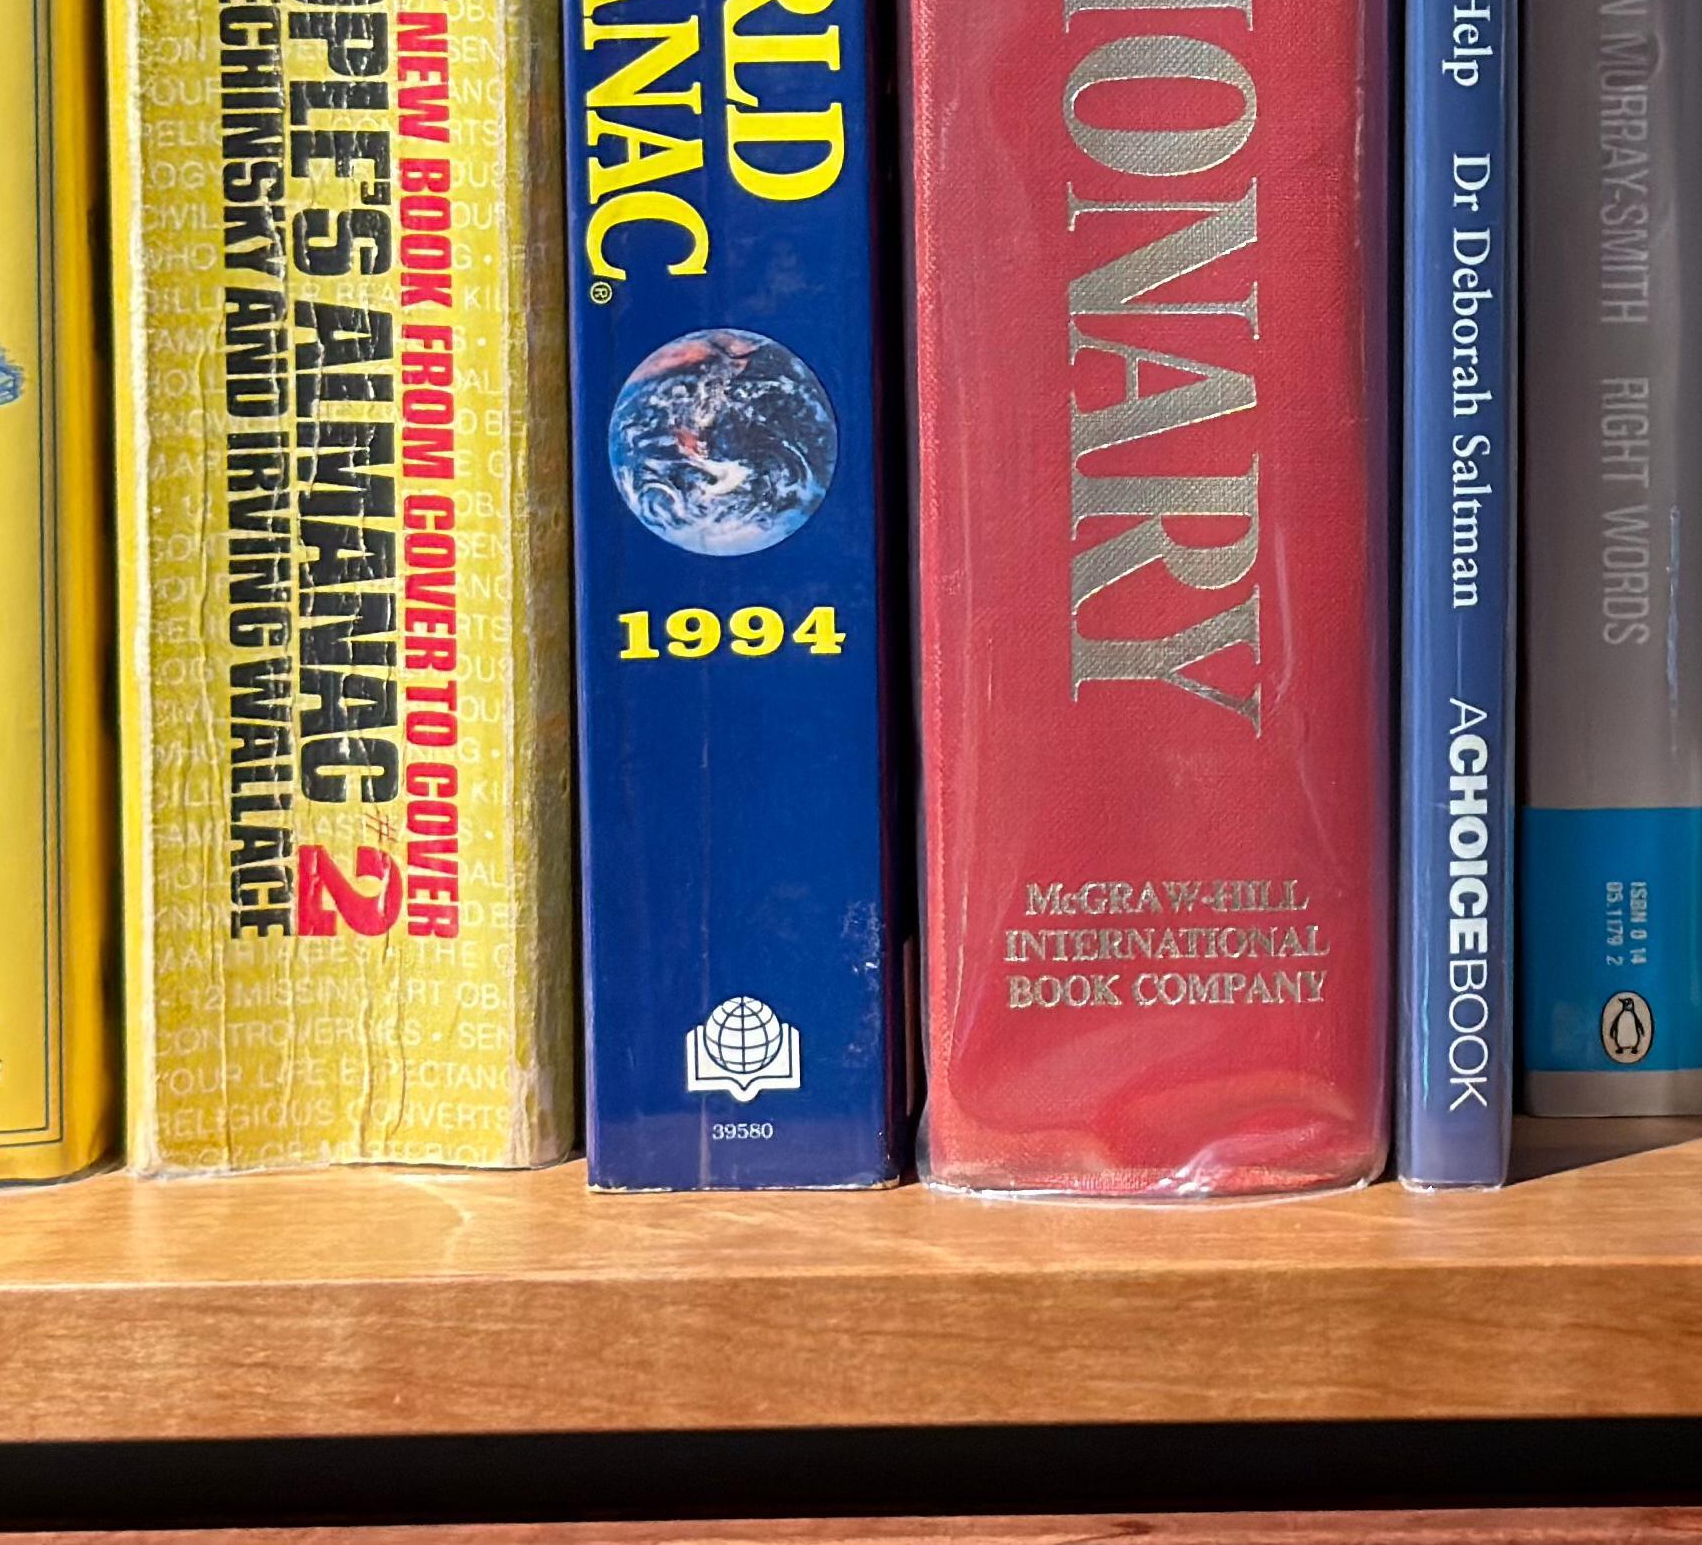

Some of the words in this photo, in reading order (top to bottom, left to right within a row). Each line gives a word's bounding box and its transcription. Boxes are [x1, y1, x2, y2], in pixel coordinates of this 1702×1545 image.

[395, 12, 450, 142] NEW
[398, 159, 452, 309] BOOK
[1452, 152, 1491, 211] Dr
[1600, 29, 1649, 326] MURRAY-SMITH
[224, 286, 288, 420] AND
[1452, 227, 1492, 417] Deborah
[402, 324, 455, 479] FROM
[1600, 377, 1649, 488] RIGHT
[227, 431, 292, 648] IRVING
[294, 299, 399, 804] ALMANAC
[402, 494, 457, 673] COVER
[1452, 434, 1492, 609] Saltman
[1601, 505, 1650, 646] WORDS
[618, 607, 846, 659] 1994
[405, 680, 458, 747] TO
[230, 656, 293, 940] WALLACE
[406, 763, 459, 938] COVER
[298, 845, 403, 936] 2
[1005, 926, 1331, 962] INTERNATIONAL
[1025, 880, 1309, 916] McGRAW-HILL
[1007, 973, 1122, 1008] BOOK
[1131, 971, 1328, 1007] COMPANY
[712, 1123, 774, 1140] 39580
